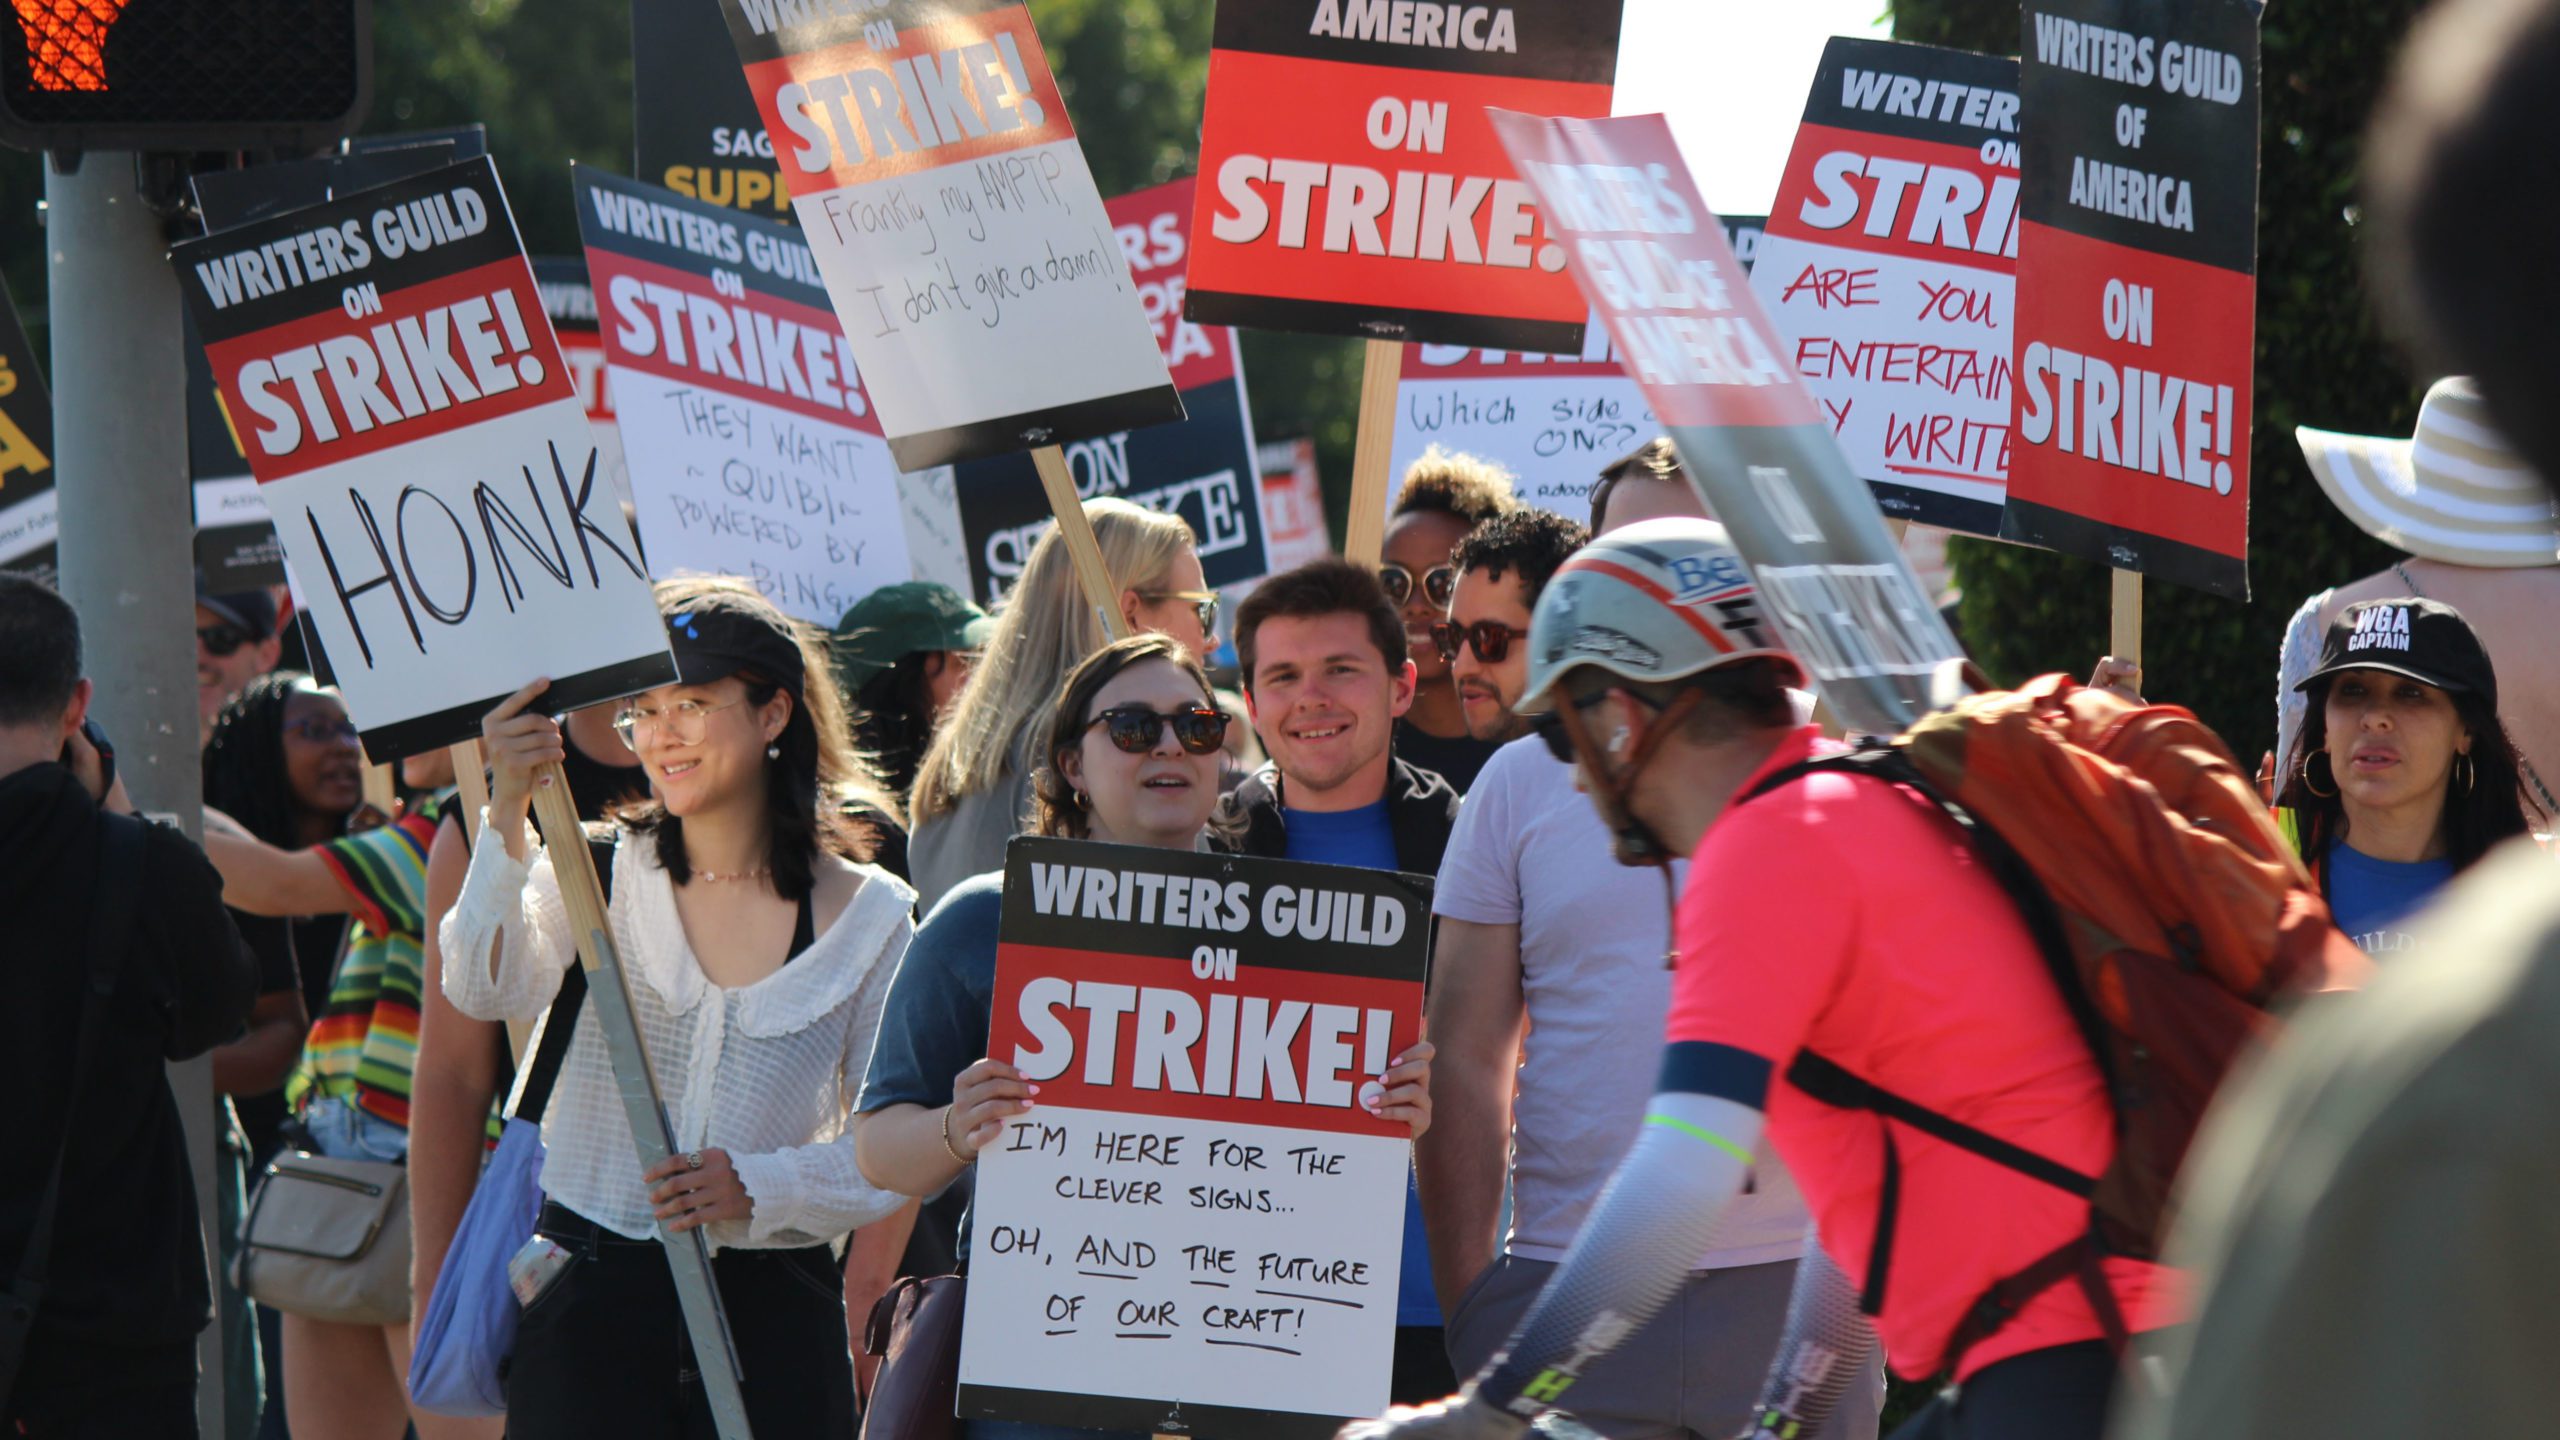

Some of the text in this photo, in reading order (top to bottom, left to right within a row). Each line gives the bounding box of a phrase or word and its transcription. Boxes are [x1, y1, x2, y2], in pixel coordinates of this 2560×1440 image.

[864, 19, 899, 52] ON
[1310, 0, 1517, 53] AMERICA
[2034, 12, 2243, 106] WRITERS GUILD
[776, 32, 1045, 173] STRIKE!
[1366, 97, 1449, 154] ON
[1841, 68, 2020, 133] WRITER
[2115, 104, 2148, 149] OF
[591, 186, 742, 263] WRITERS
[822, 185, 937, 255] Frankly
[940, 186, 986, 242] my
[1800, 150, 2020, 258] STRI
[2069, 156, 2194, 234] AMERICA
[197, 187, 488, 310] WRITERS GUILD
[712, 267, 745, 299] ON
[856, 226, 1121, 338] I don't give a damn!
[343, 281, 382, 320] ON
[1782, 262, 1998, 329] ARE YOU
[2103, 278, 2154, 347] ON
[238, 288, 546, 456] STRIKE!
[609, 274, 868, 417] STRIKE!
[664, 389, 863, 482] THEY WANT
[1410, 391, 1623, 433] Which side
[1534, 424, 1637, 457] ON??
[2021, 341, 2234, 497] STRIKE!
[1065, 431, 1132, 500] ON
[306, 439, 645, 669] HONK
[669, 492, 866, 566] POWERED BY
[2348, 631, 2410, 652] CAPTAIN
[2354, 604, 2410, 634] WGA
[1030, 861, 1406, 947] WRITERS GUILD
[1191, 945, 1238, 982] ON
[1013, 976, 1393, 1113] STRIKE!
[1006, 1122, 1347, 1176] I'M HERE FOR THE
[1055, 1175, 1295, 1214] CLEVER SIGNS...
[990, 1226, 1370, 1287] OH, AND THE FUTURE
[1045, 1293, 1305, 1338] OF OUR CRAFT!
